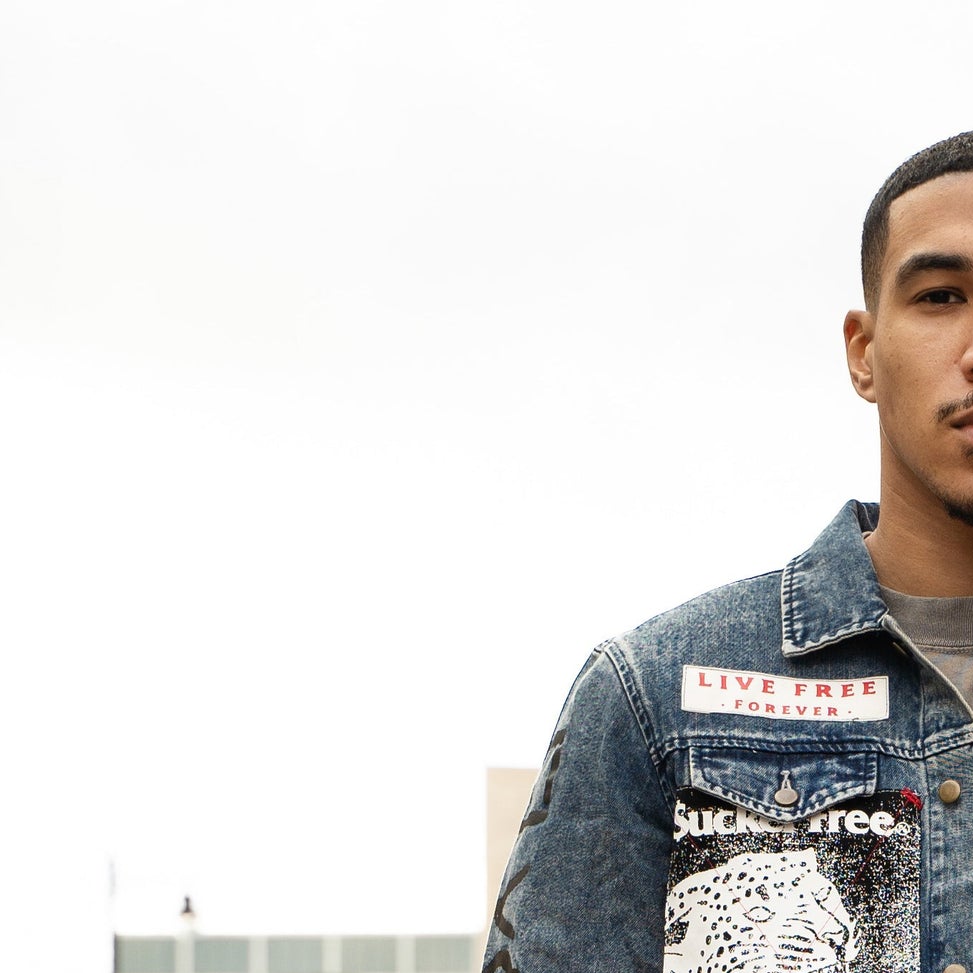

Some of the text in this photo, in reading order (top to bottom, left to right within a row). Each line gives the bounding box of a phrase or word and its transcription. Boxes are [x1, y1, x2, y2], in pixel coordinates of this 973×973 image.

[698, 672, 877, 698] LIVE FREE
[734, 699, 839, 717] FOREVER
